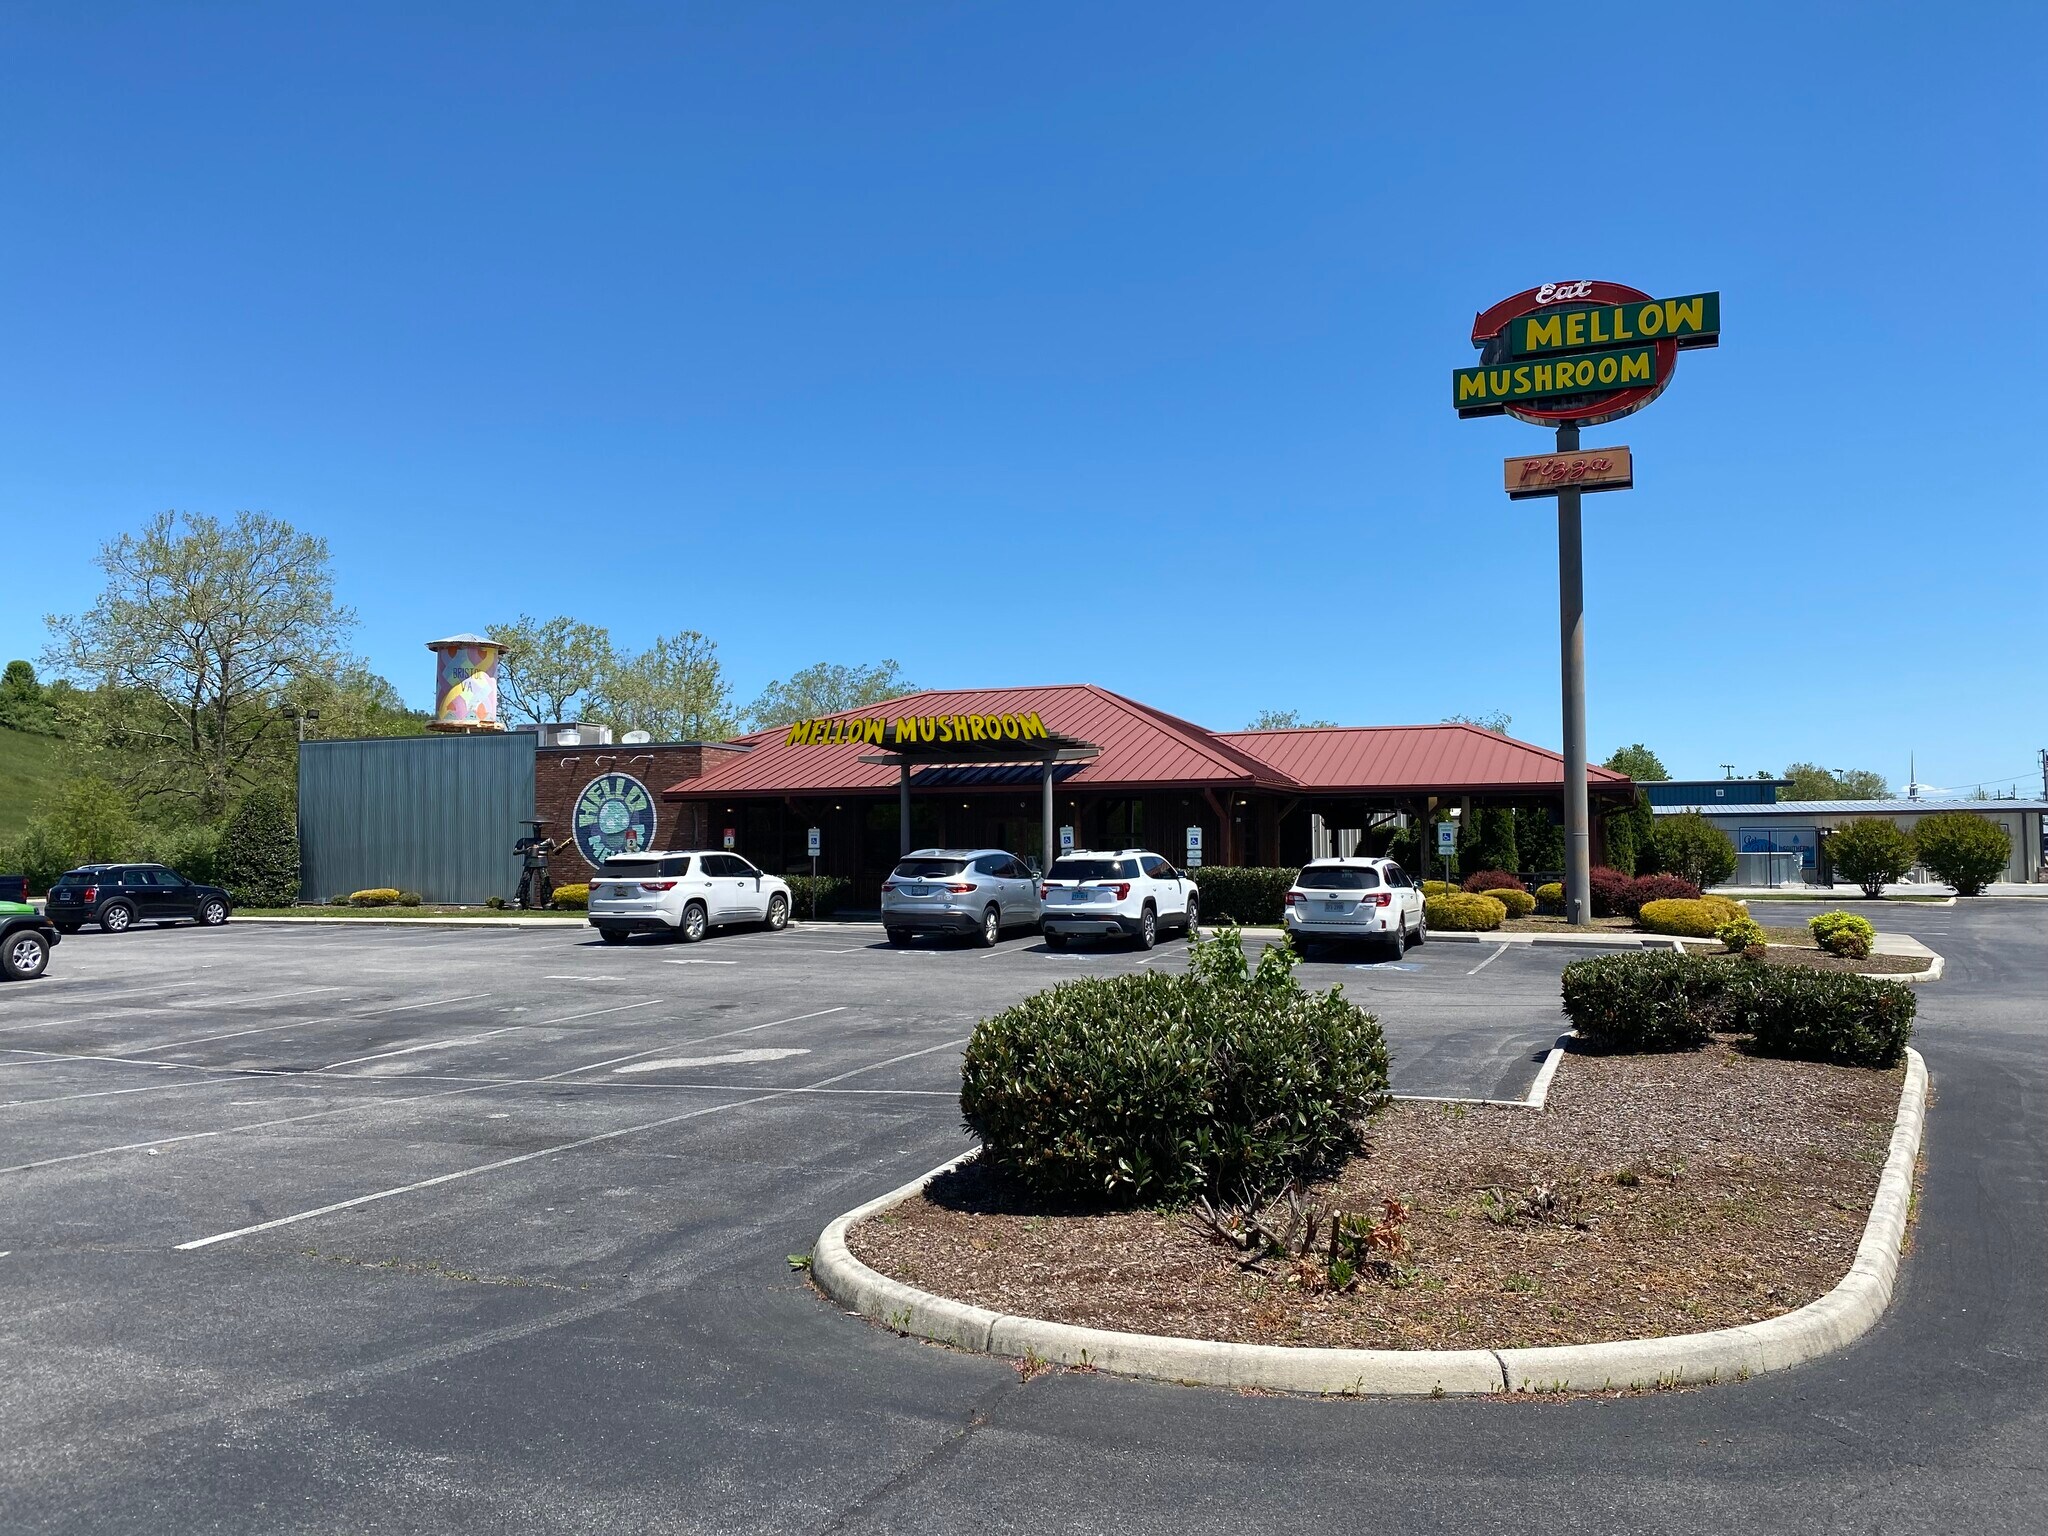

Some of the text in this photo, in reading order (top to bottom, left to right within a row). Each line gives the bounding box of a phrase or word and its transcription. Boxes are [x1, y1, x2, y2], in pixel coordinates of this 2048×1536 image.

[1535, 280, 1593, 304] Eat
[1526, 297, 1704, 352] MELLOW
[1459, 352, 1650, 401] MUSHROOM
[1522, 457, 1613, 481] Pizza
[461, 681, 473, 692] VA
[785, 711, 1048, 747] MELLOW MUSHROOM
[578, 777, 648, 828] HELLO
